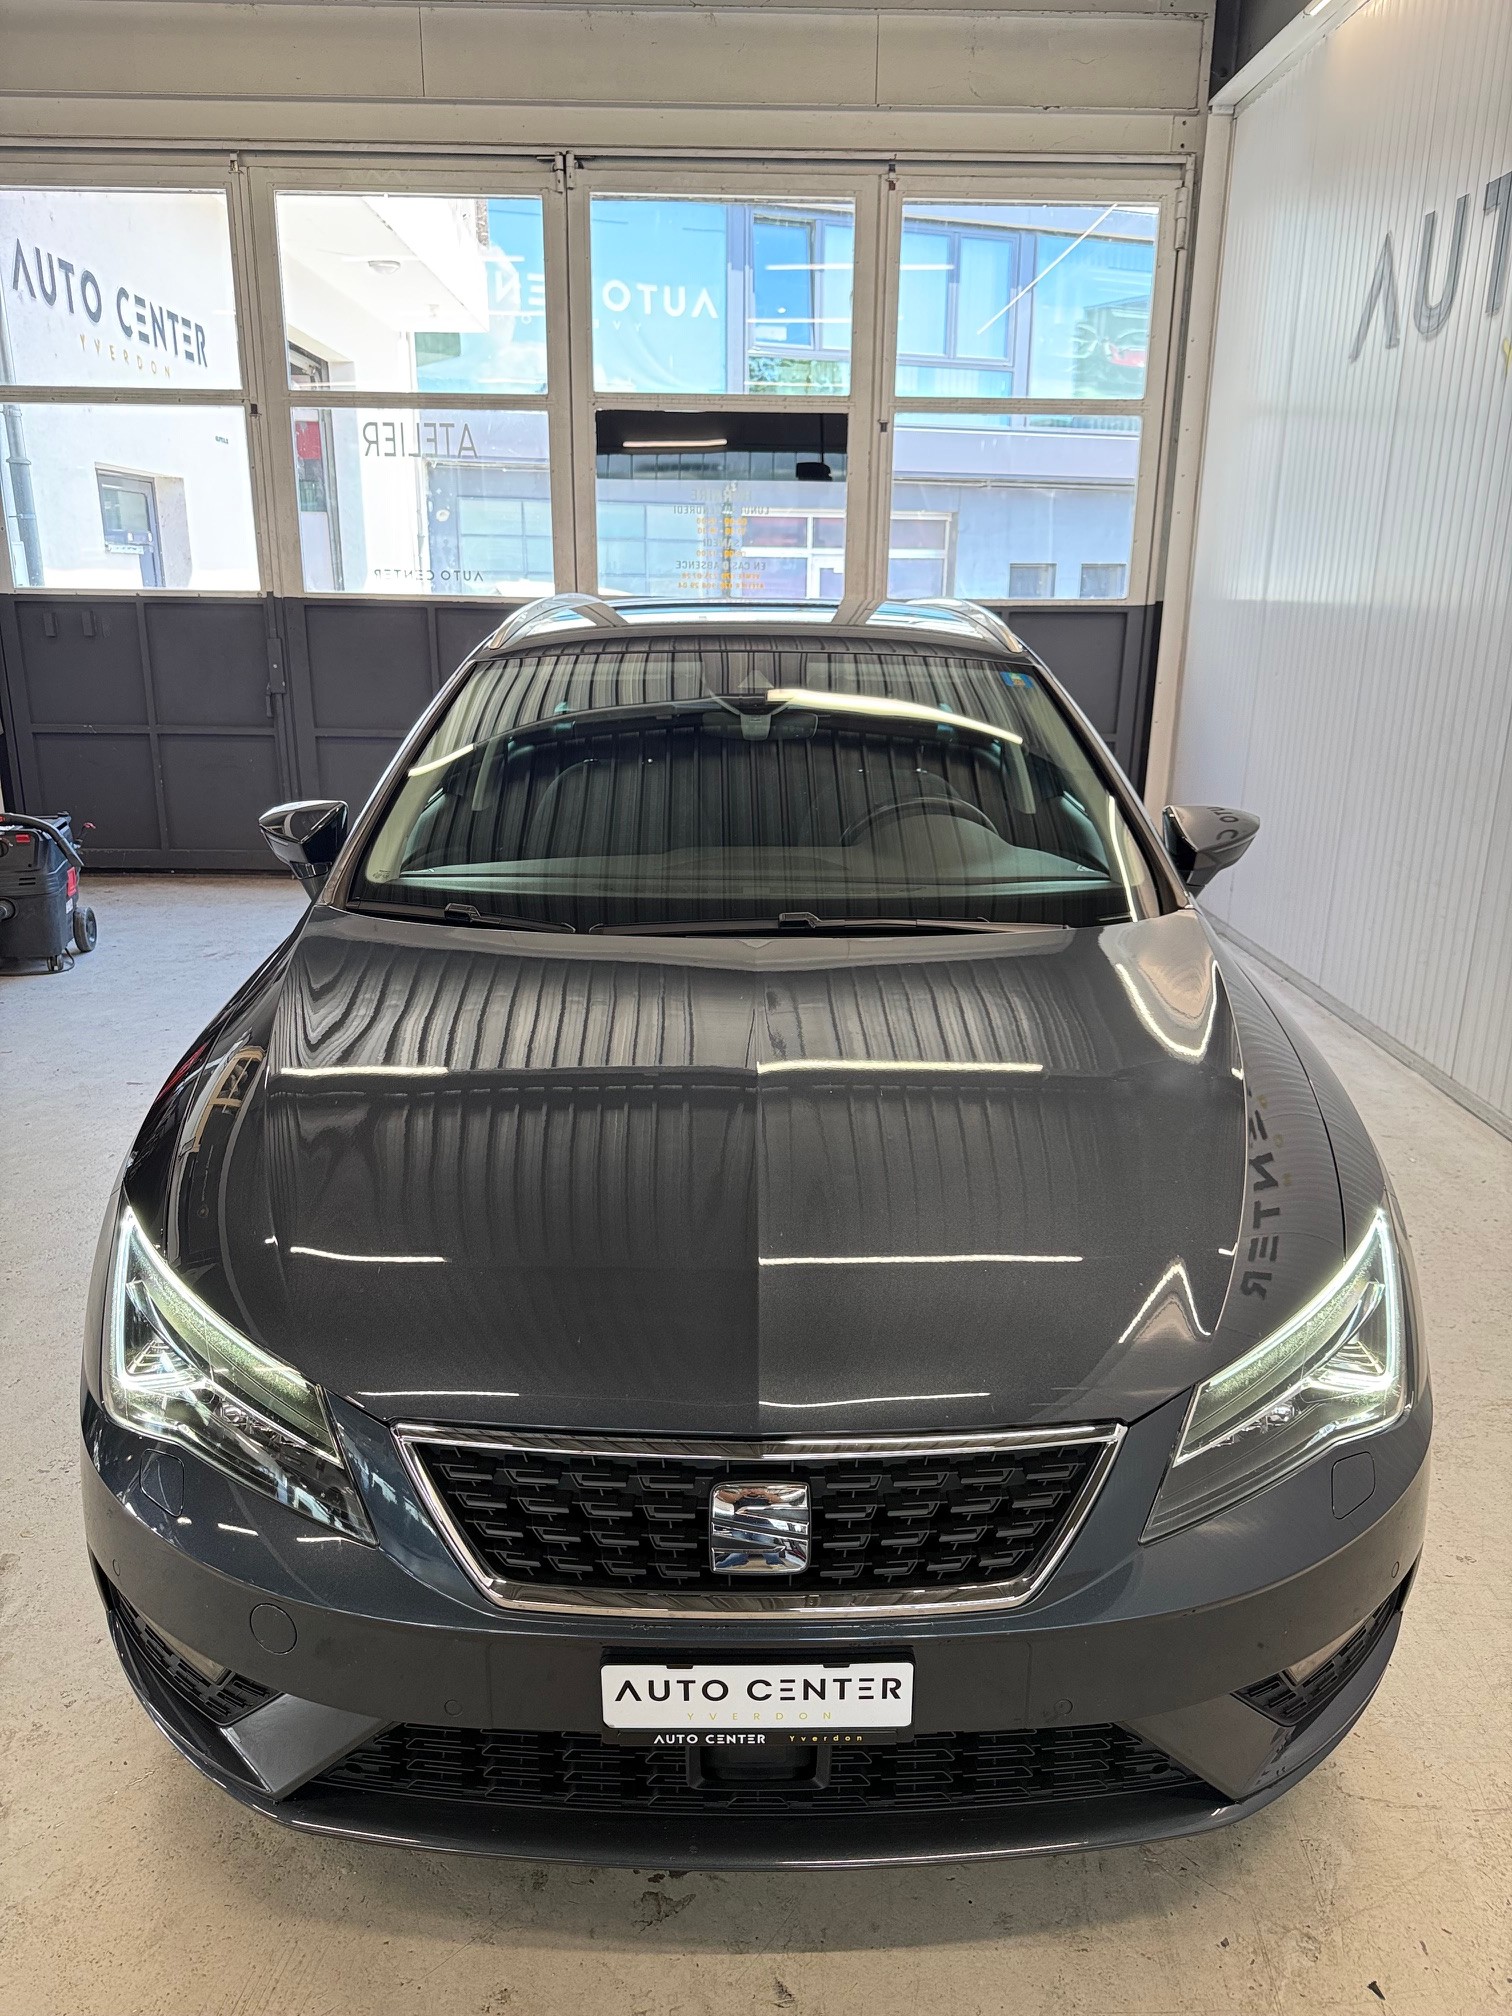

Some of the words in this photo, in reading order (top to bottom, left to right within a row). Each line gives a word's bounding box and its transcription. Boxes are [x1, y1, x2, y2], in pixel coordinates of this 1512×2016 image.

[13, 238, 101, 324] AUTO
[116, 286, 208, 368] CENTER
[79, 333, 171, 378] YVERDON
[615, 1679, 729, 1702] AUTO
[746, 1677, 902, 1701] CENTER
[687, 1711, 832, 1721] YVERDON
[653, 1733, 698, 1744] AUTO
[705, 1733, 766, 1744] CENTER
[789, 1734, 863, 1742] Yverdon
